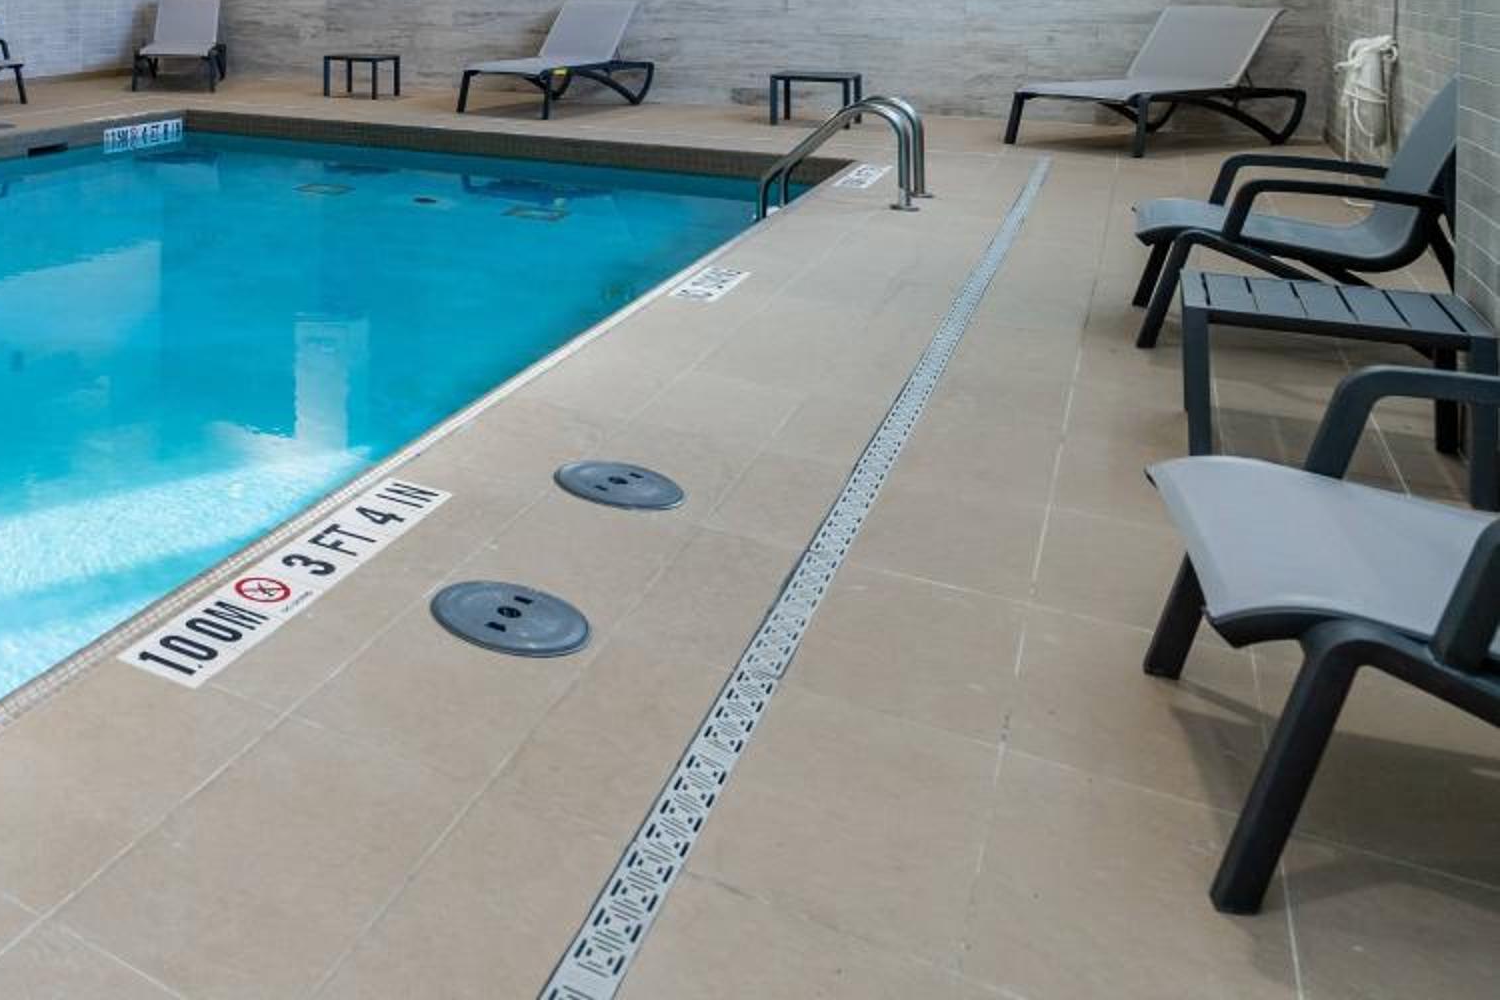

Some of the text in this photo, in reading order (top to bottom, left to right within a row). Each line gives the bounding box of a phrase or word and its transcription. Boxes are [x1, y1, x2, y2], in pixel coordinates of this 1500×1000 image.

[375, 483, 439, 508] IN
[355, 506, 405, 525] 4
[308, 523, 377, 556] FT
[281, 554, 336, 576] 3
